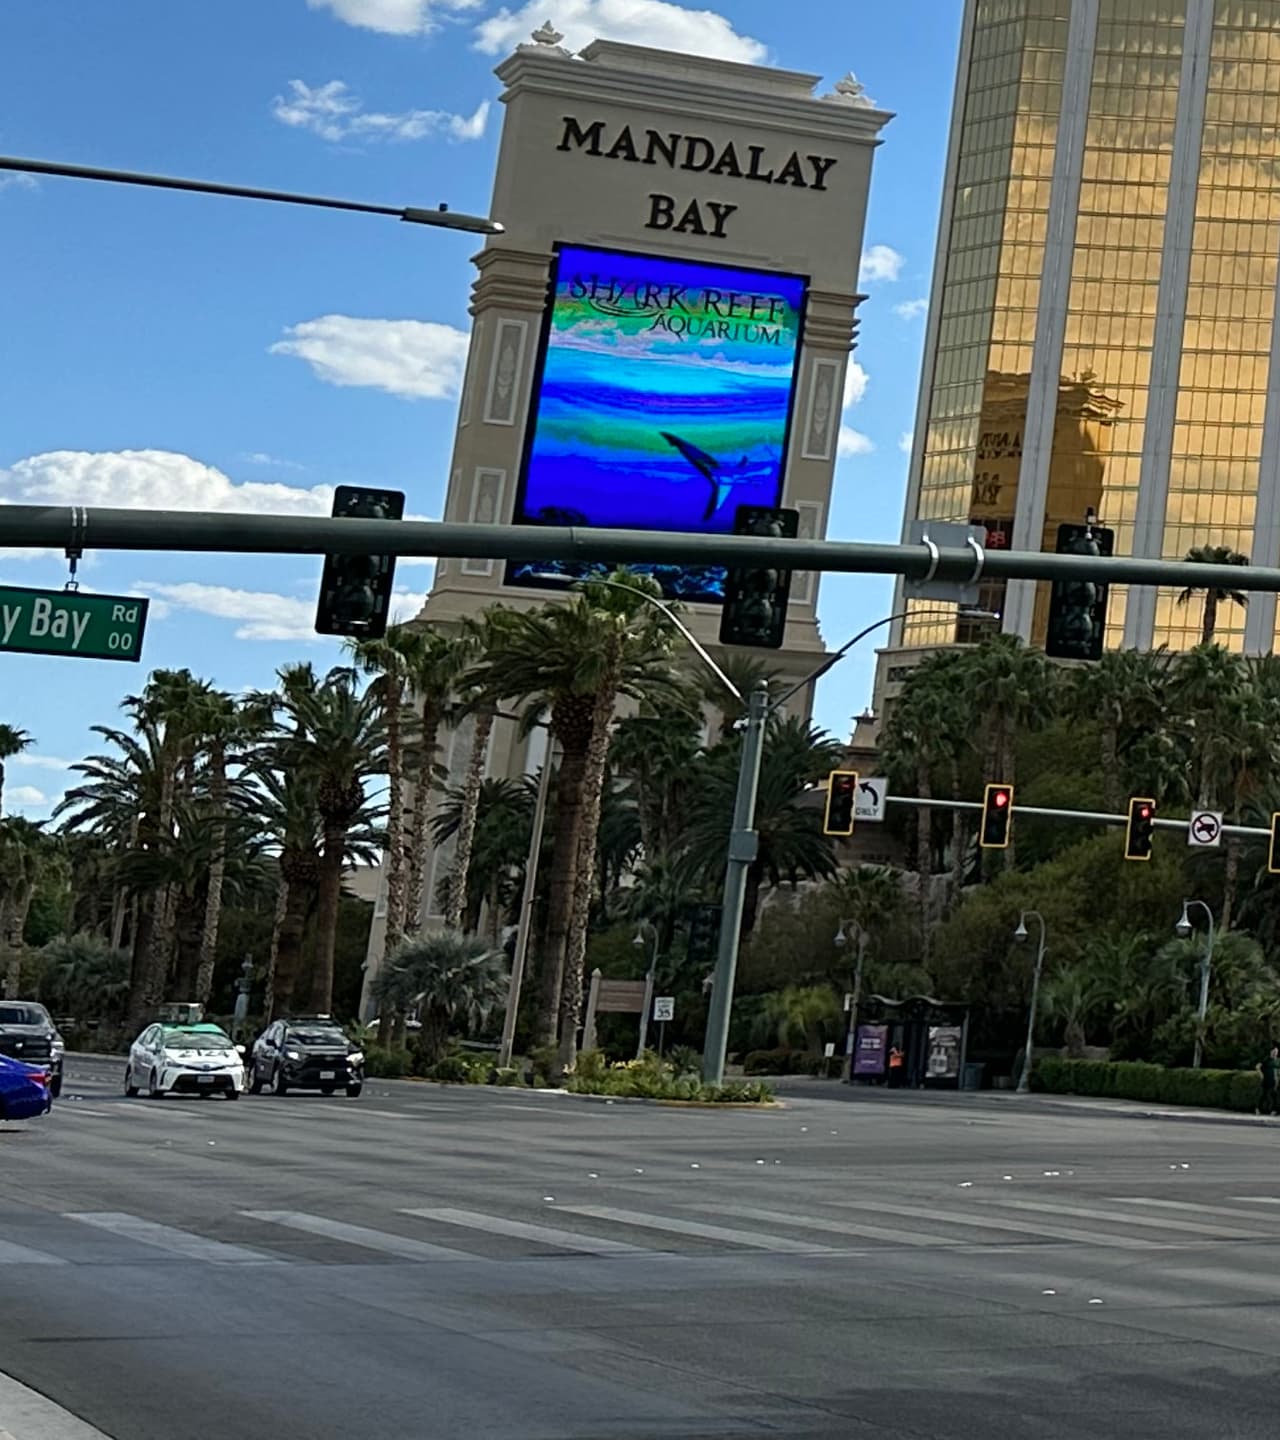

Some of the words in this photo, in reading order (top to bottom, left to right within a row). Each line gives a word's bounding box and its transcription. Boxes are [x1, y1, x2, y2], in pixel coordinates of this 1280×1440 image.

[556, 116, 838, 191] MANDALAY
[644, 193, 738, 238] BAY
[569, 272, 690, 316] SHARK
[704, 287, 786, 323] REEF
[649, 313, 782, 346] AQUARIUM
[30, 598, 91, 650] Bay
[111, 604, 138, 623] Rd
[108, 631, 133, 650] 00
